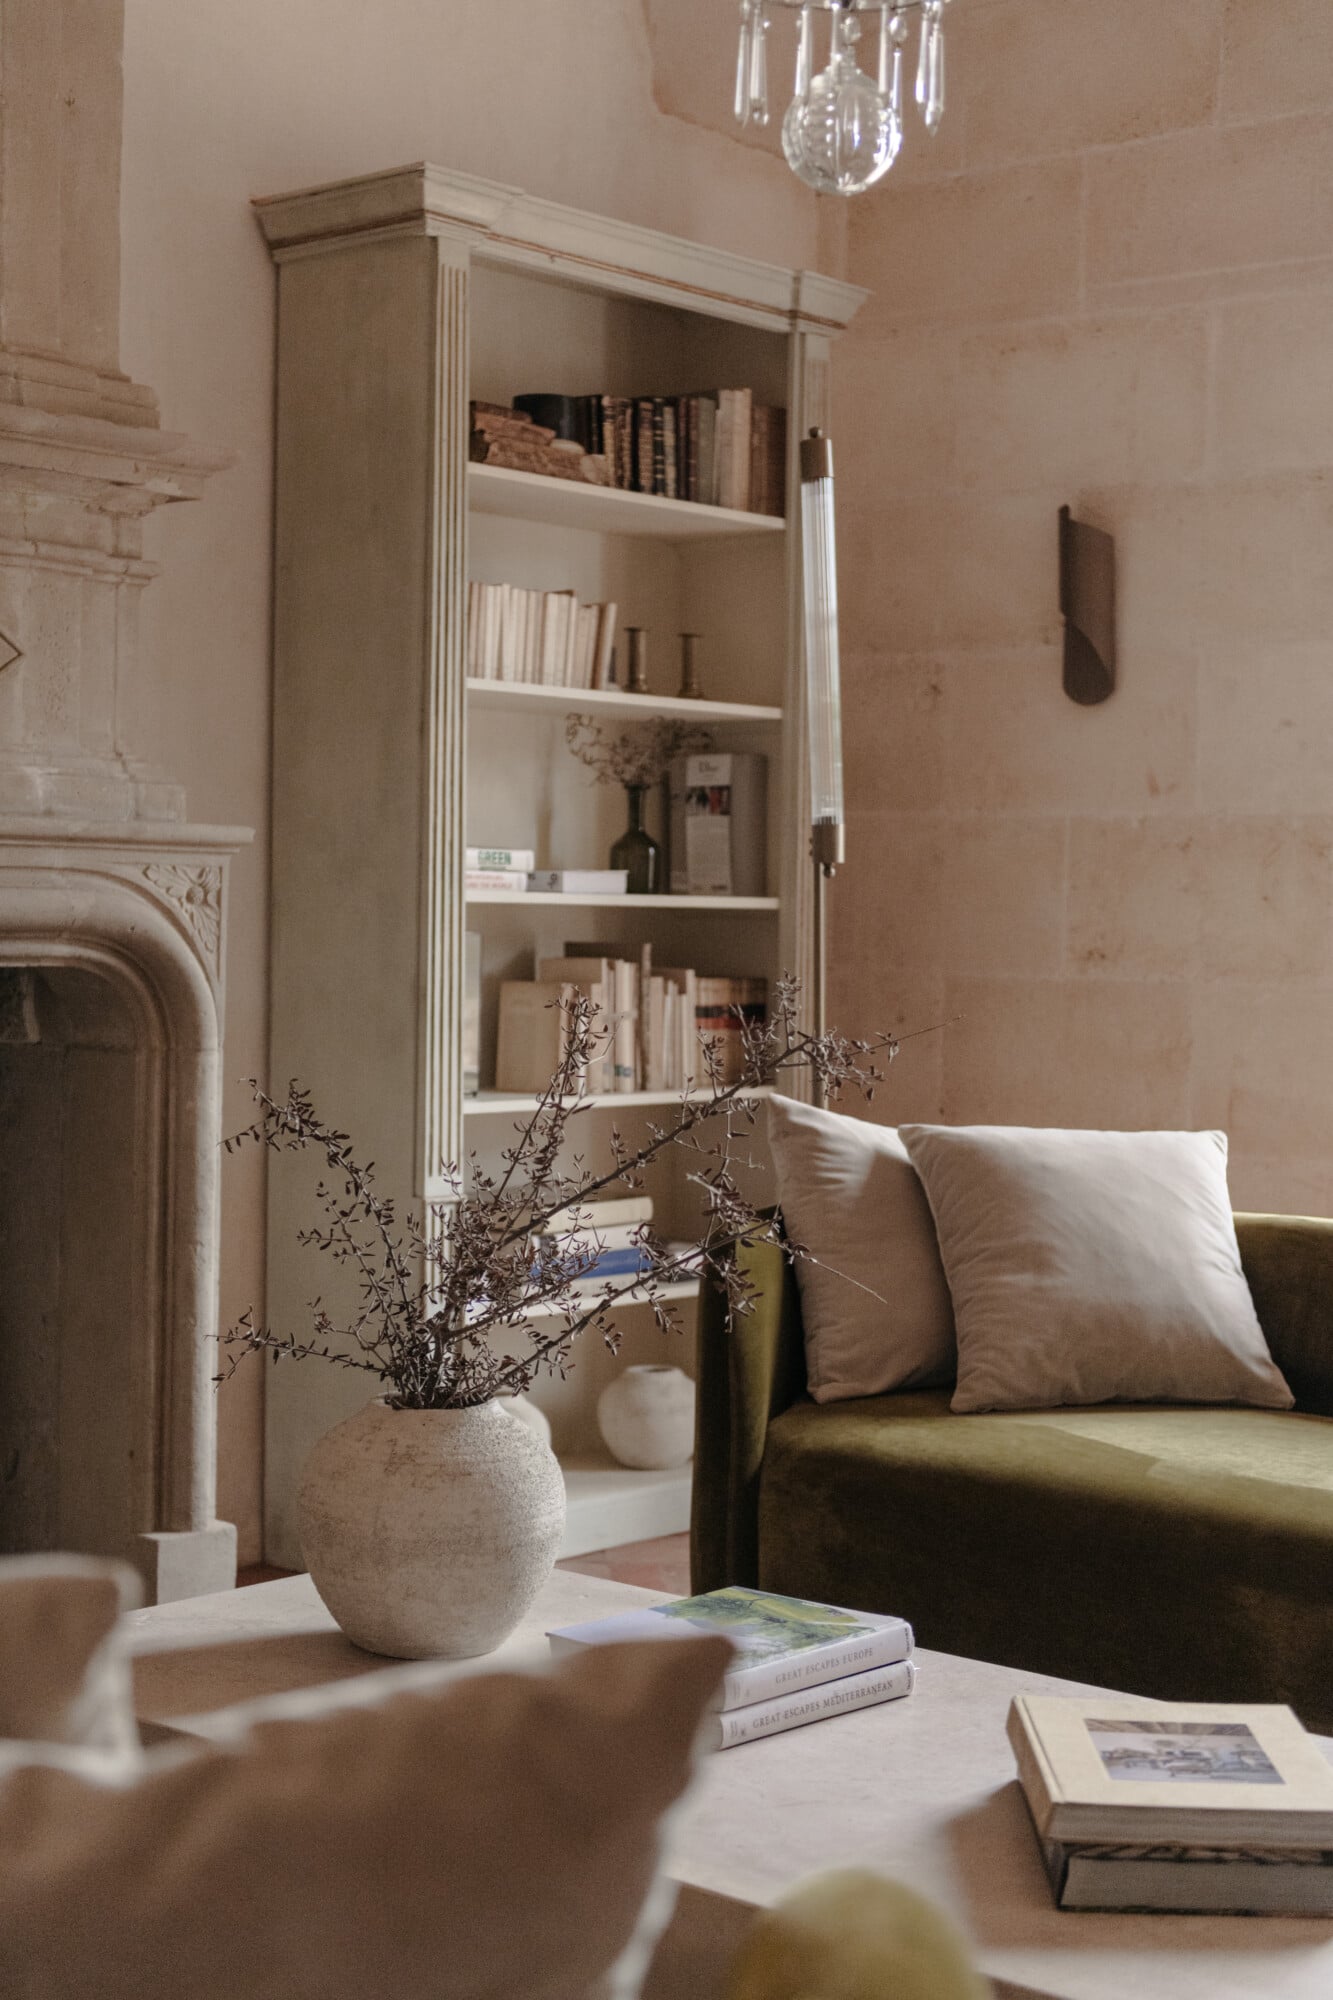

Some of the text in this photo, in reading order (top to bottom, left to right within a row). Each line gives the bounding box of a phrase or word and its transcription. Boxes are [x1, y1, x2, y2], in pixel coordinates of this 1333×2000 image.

[478, 850, 511, 865] GREEN
[775, 1648, 873, 1684] GREAT ESCAPES EUROPE
[752, 1713, 780, 1729] GREAT
[784, 1702, 820, 1719] ESCAPES
[823, 1680, 894, 1709] MEDITERRANEAN
